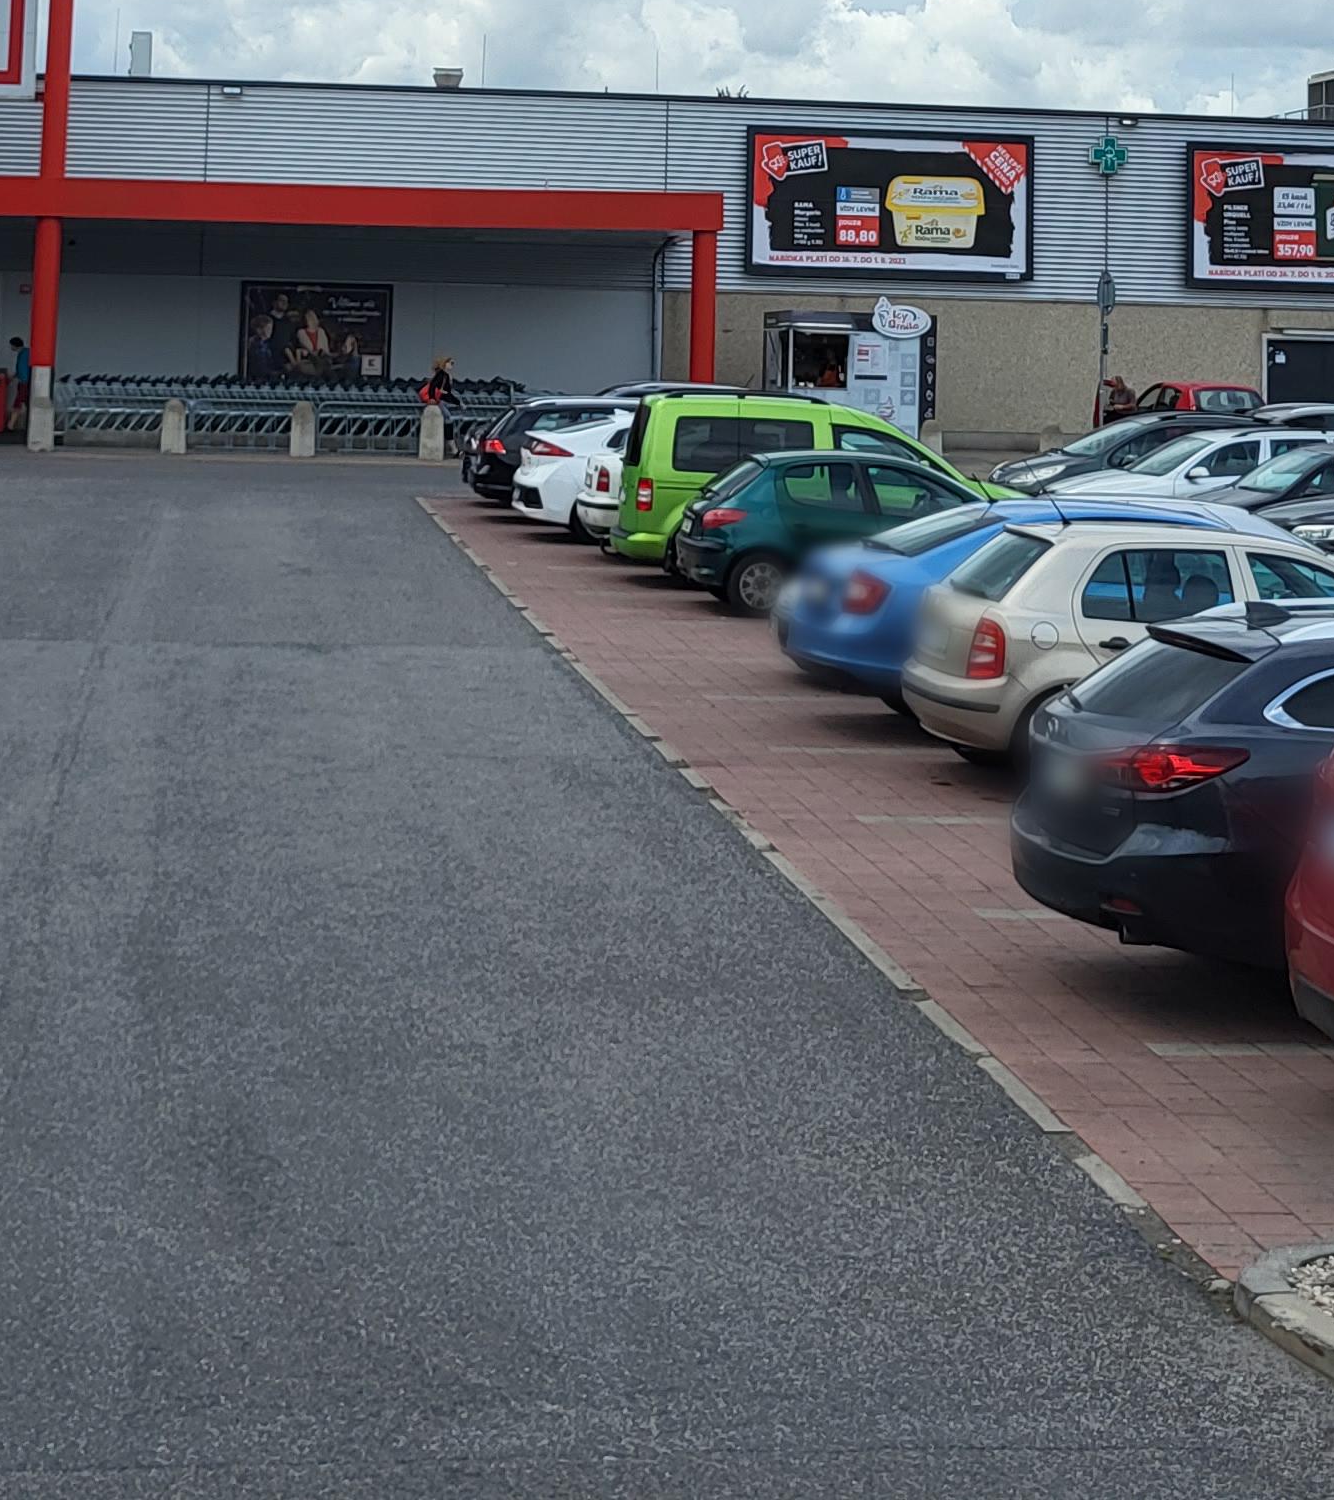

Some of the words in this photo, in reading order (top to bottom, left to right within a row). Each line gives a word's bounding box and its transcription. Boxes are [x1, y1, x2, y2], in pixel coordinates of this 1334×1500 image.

[787, 145, 821, 161] SUPER
[789, 154, 823, 170] KAUF!
[1225, 162, 1257, 176] SUPER
[1227, 171, 1259, 186] KAUF!
[913, 187, 958, 196] Rama
[915, 224, 951, 236] Rama
[1277, 243, 1314, 258] 357,90
[861, 256, 872, 264] DO
[893, 310, 908, 323] Icy
